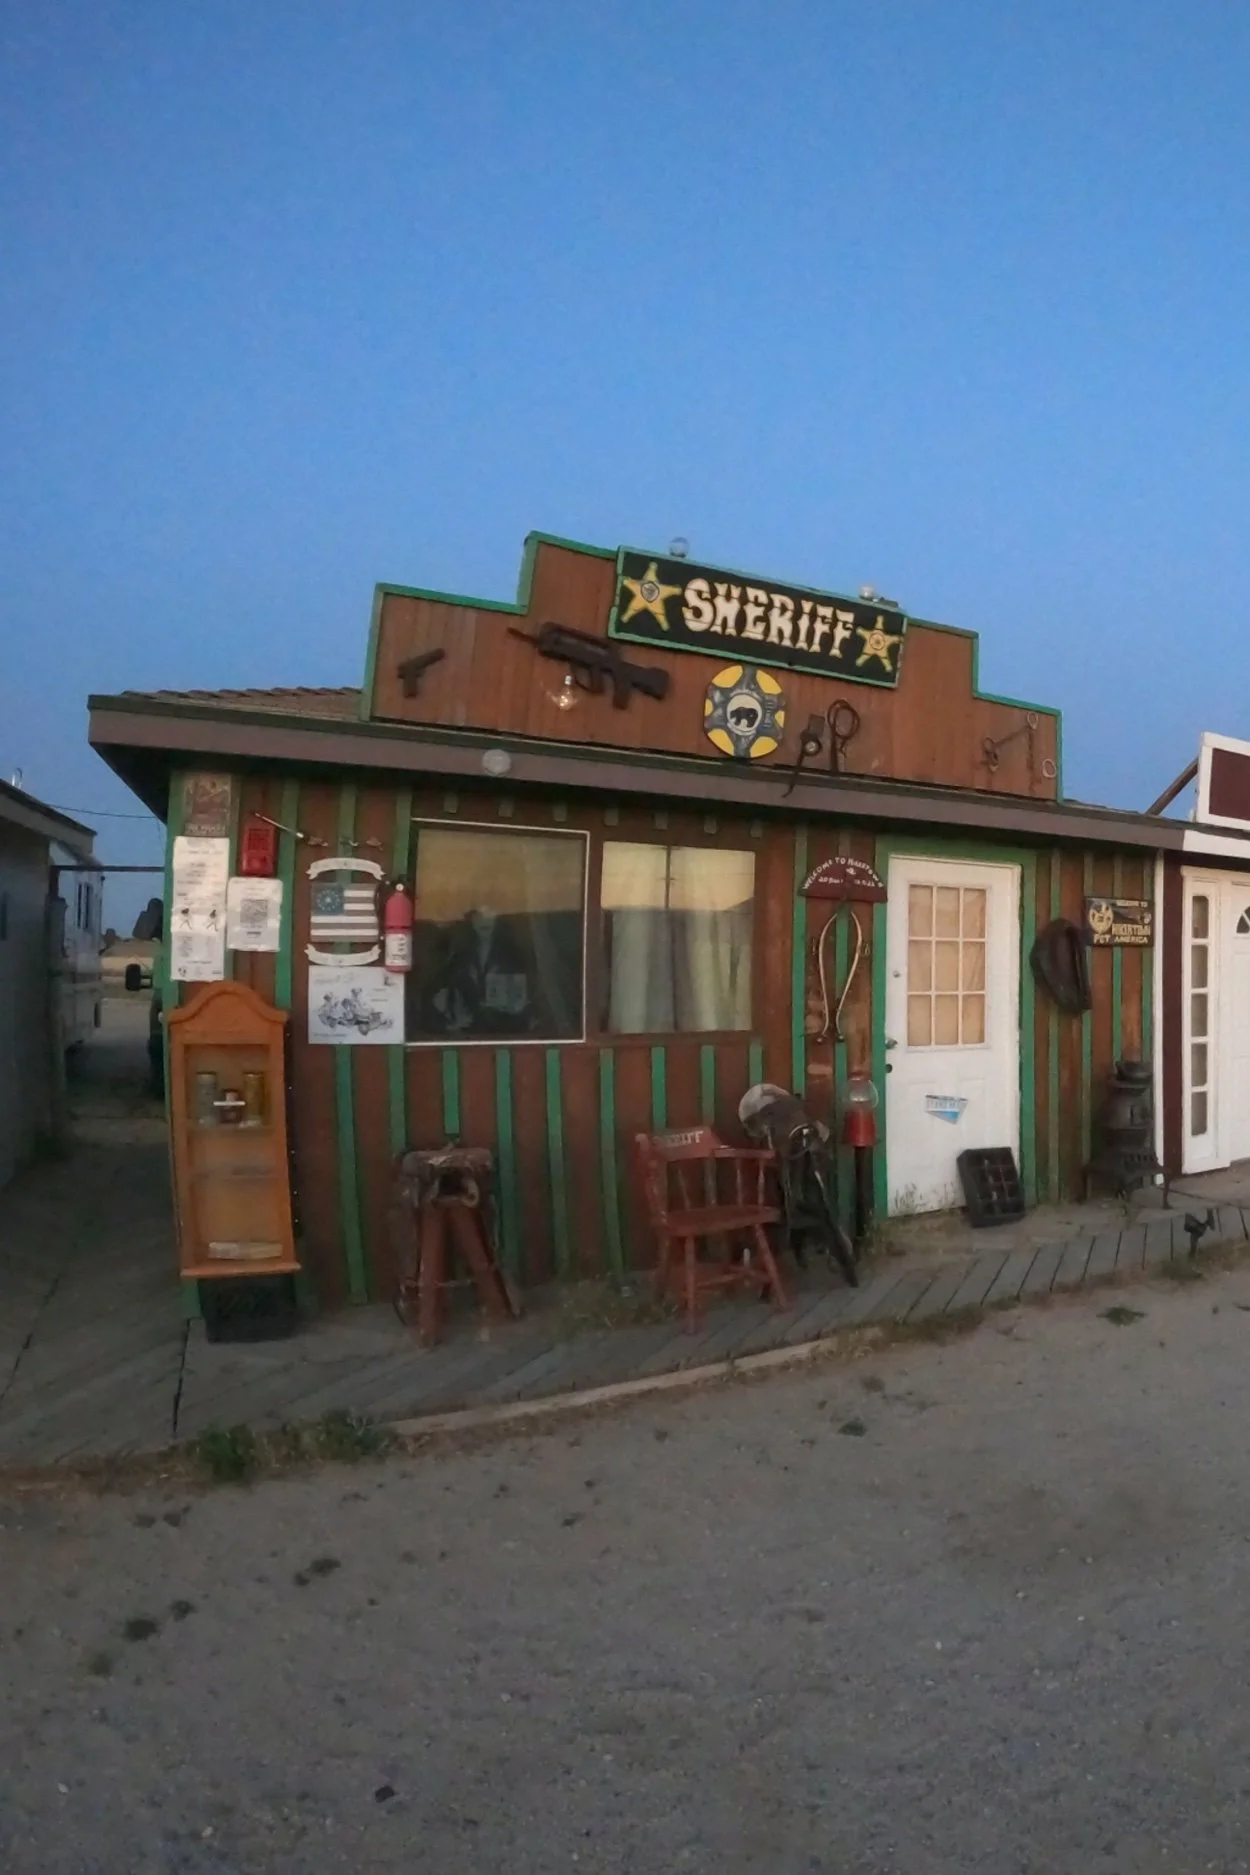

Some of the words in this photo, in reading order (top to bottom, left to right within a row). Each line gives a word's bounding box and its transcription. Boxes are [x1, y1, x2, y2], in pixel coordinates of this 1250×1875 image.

[682, 578, 854, 659] SHERIFF
[802, 859, 833, 889] WELCOME
[834, 856, 846, 865] TO
